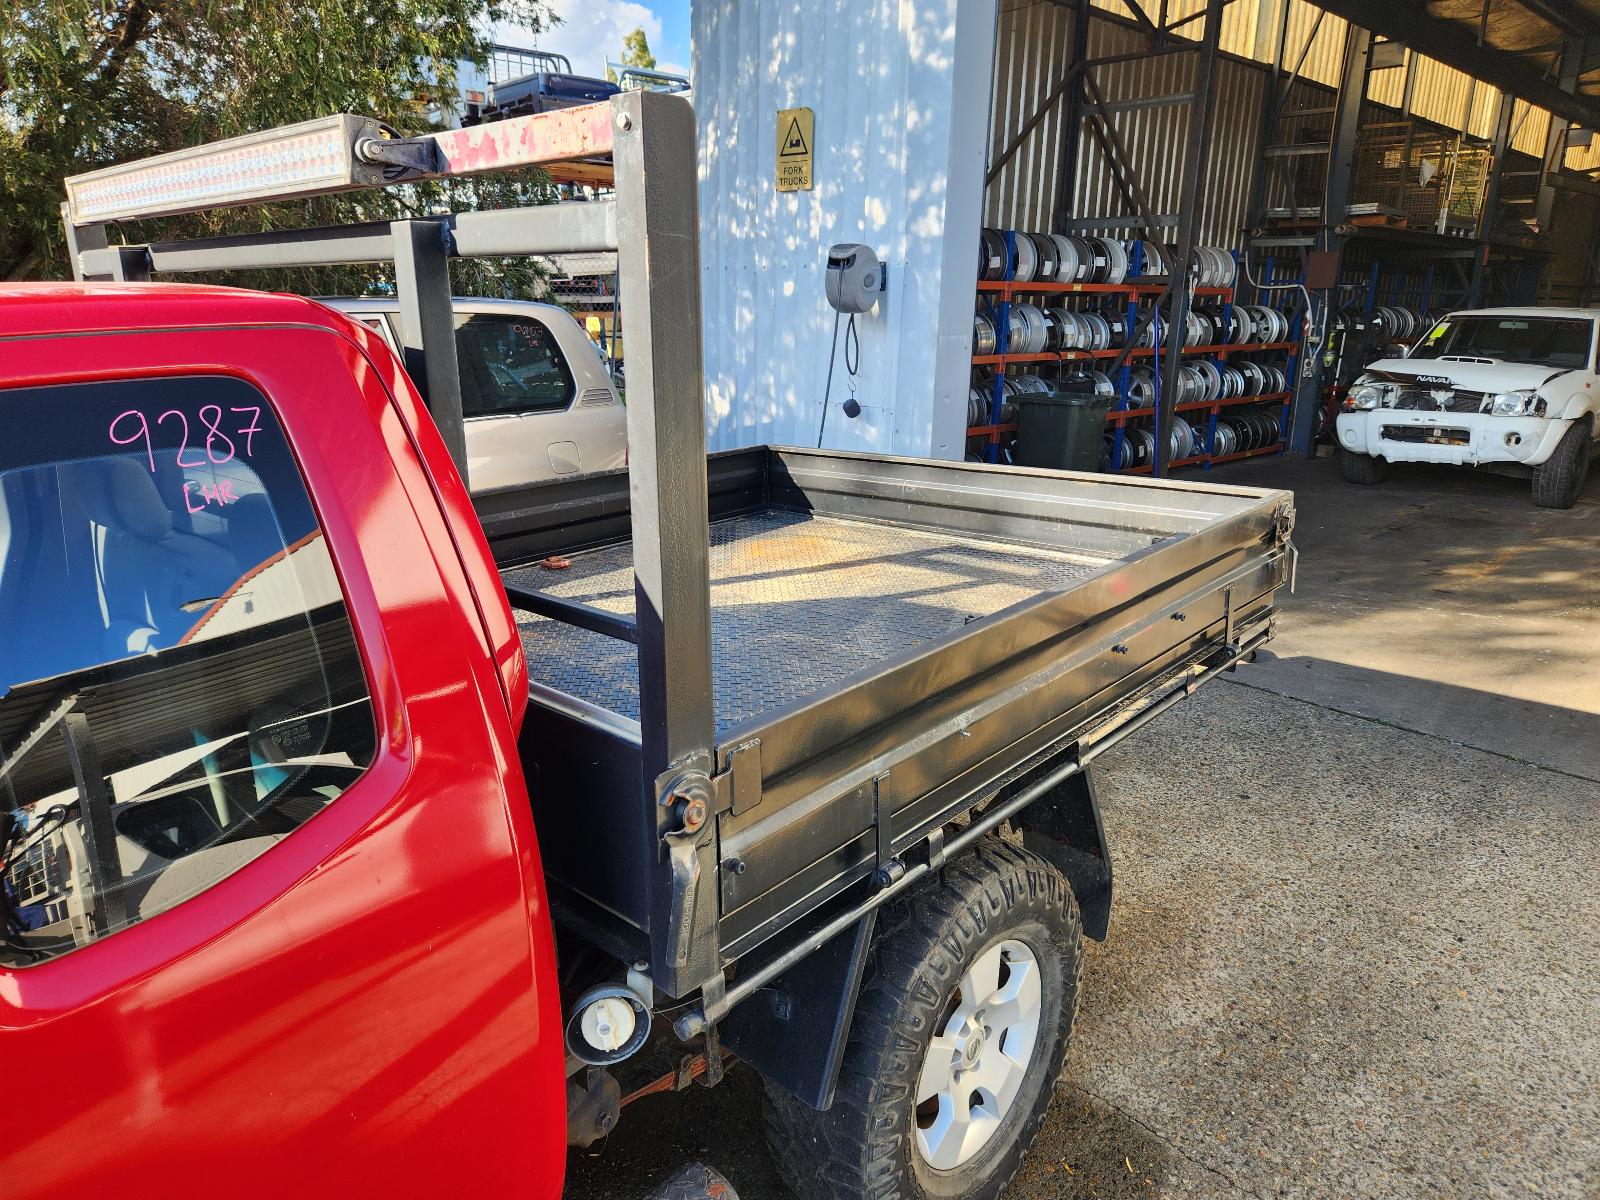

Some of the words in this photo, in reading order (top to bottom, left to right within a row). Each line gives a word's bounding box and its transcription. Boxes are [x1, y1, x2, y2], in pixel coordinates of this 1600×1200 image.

[783, 166, 803, 175] FORK
[779, 176, 809, 187] TRUCKS
[1416, 375, 1457, 385] NAVAR
[109, 404, 263, 473] 9287
